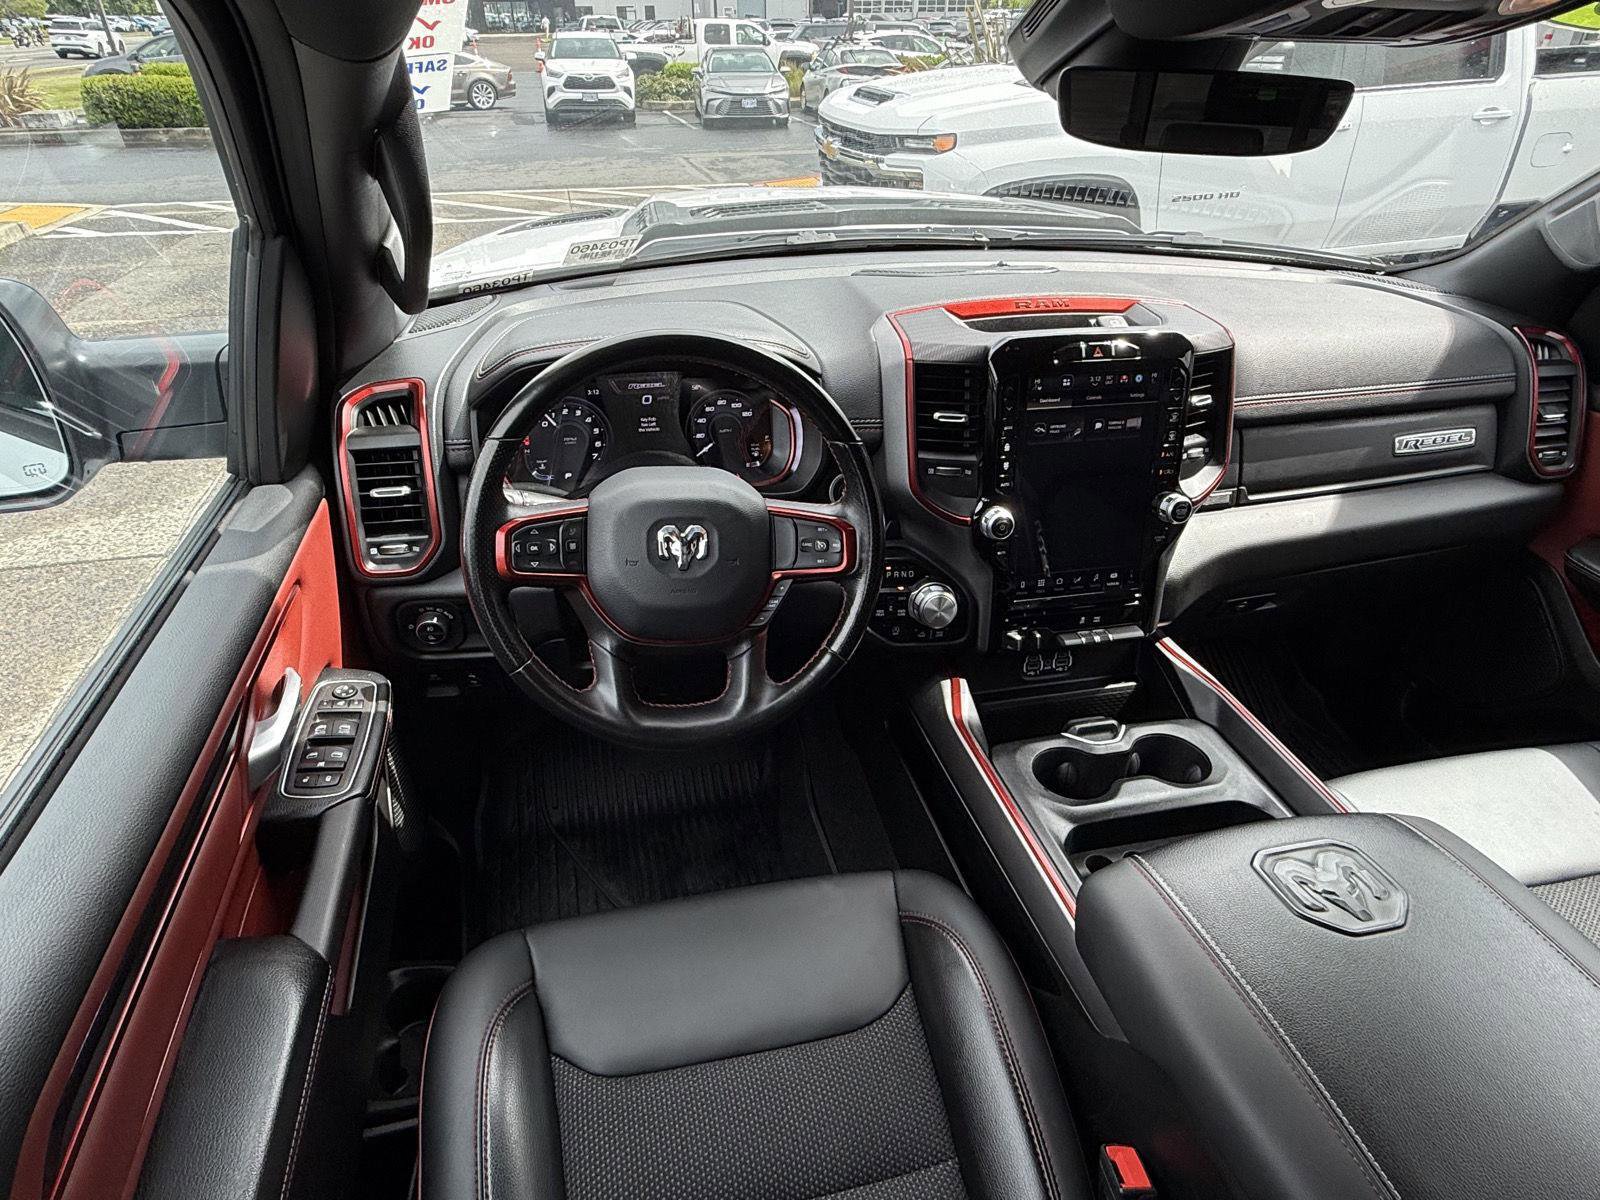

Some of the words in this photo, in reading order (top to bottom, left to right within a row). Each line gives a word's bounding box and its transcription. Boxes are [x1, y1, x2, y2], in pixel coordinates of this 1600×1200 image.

[1171, 192, 1214, 203] 2500
[1217, 190, 1241, 199] HD
[1014, 298, 1070, 309] RAM
[641, 394, 653, 405] 0
[1396, 432, 1472, 451] REBEL
[565, 472, 573, 480] P
